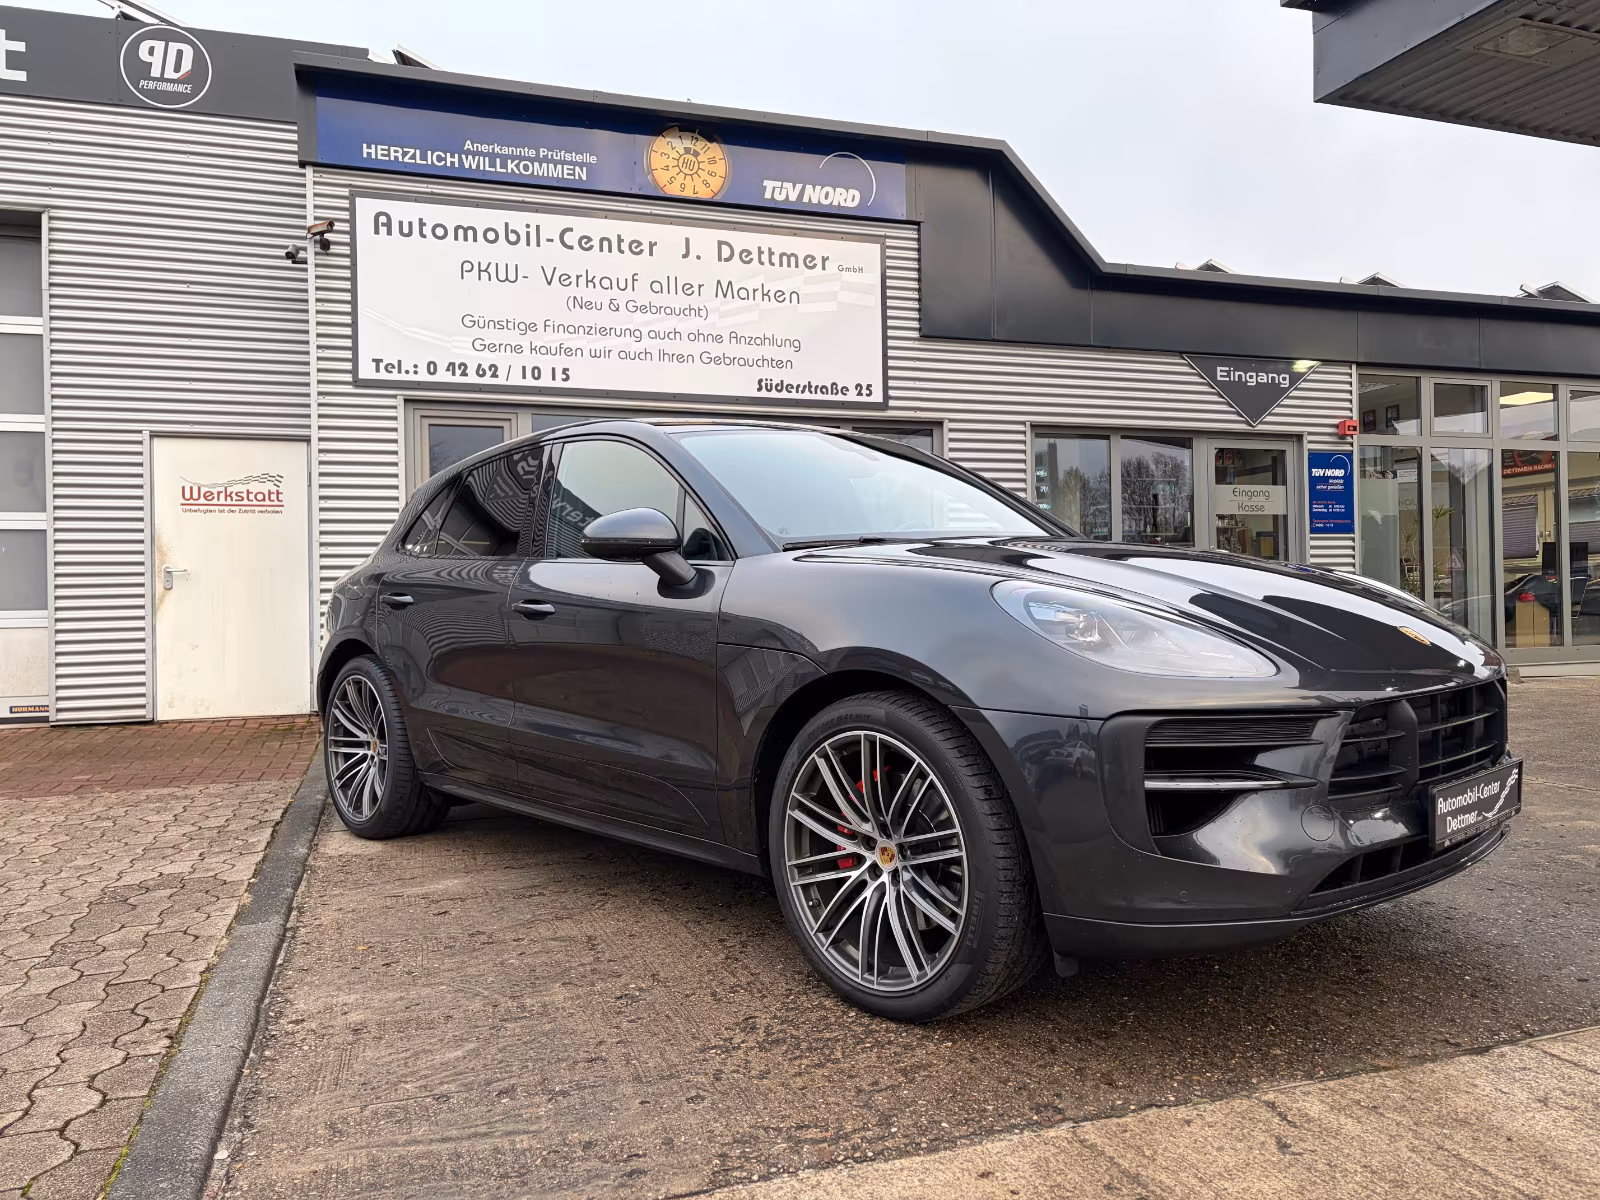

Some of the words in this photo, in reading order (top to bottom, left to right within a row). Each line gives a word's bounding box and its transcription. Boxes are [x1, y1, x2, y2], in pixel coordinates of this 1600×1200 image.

[139, 79, 193, 94] PERFORMANCE
[362, 143, 459, 168] HERZLICH
[461, 154, 588, 181] WILLKOMMEN
[463, 140, 536, 158] Anerkannte
[539, 148, 598, 164] Prüfstelle
[681, 156, 696, 172] HU
[763, 180, 803, 202] TÜV
[802, 184, 861, 208] NORD
[373, 210, 658, 257] Automobil-Center
[681, 236, 702, 261] J.
[716, 239, 830, 272] Dettmer
[837, 264, 864, 274] GmbH
[460, 259, 529, 284] PKW-
[541, 265, 639, 292] Verkauf
[649, 275, 705, 297] aller
[714, 279, 801, 305] Marken
[566, 295, 603, 312] (Neu
[608, 299, 620, 312] &
[625, 300, 709, 320] Gebraucht)
[461, 313, 538, 336] Günstige
[543, 318, 643, 343] Finanzierung
[648, 327, 682, 342] auch
[687, 331, 724, 345] ohne
[729, 331, 802, 352] Anzahlung
[471, 337, 524, 355] Gerne
[529, 341, 584, 358] kaufen
[589, 346, 612, 359] wir
[618, 347, 653, 362] auch
[658, 348, 695, 364] Ihren
[700, 351, 793, 370] Gebrauchten
[371, 358, 419, 376] Tel.:
[445, 361, 469, 378] 42
[475, 363, 499, 379] 62
[521, 365, 542, 381] 10
[551, 366, 571, 382] 15
[1216, 366, 1290, 388] Eingang
[756, 377, 850, 396] Süderstraße
[854, 383, 873, 398] 25
[1324, 468, 1345, 477] NORD
[181, 485, 284, 503] Werkstatt
[1232, 487, 1271, 500] Eingang
[1237, 502, 1266, 513] Kasse
[1437, 780, 1501, 815] Automobil-Center
[1446, 810, 1478, 833] Dettmer
